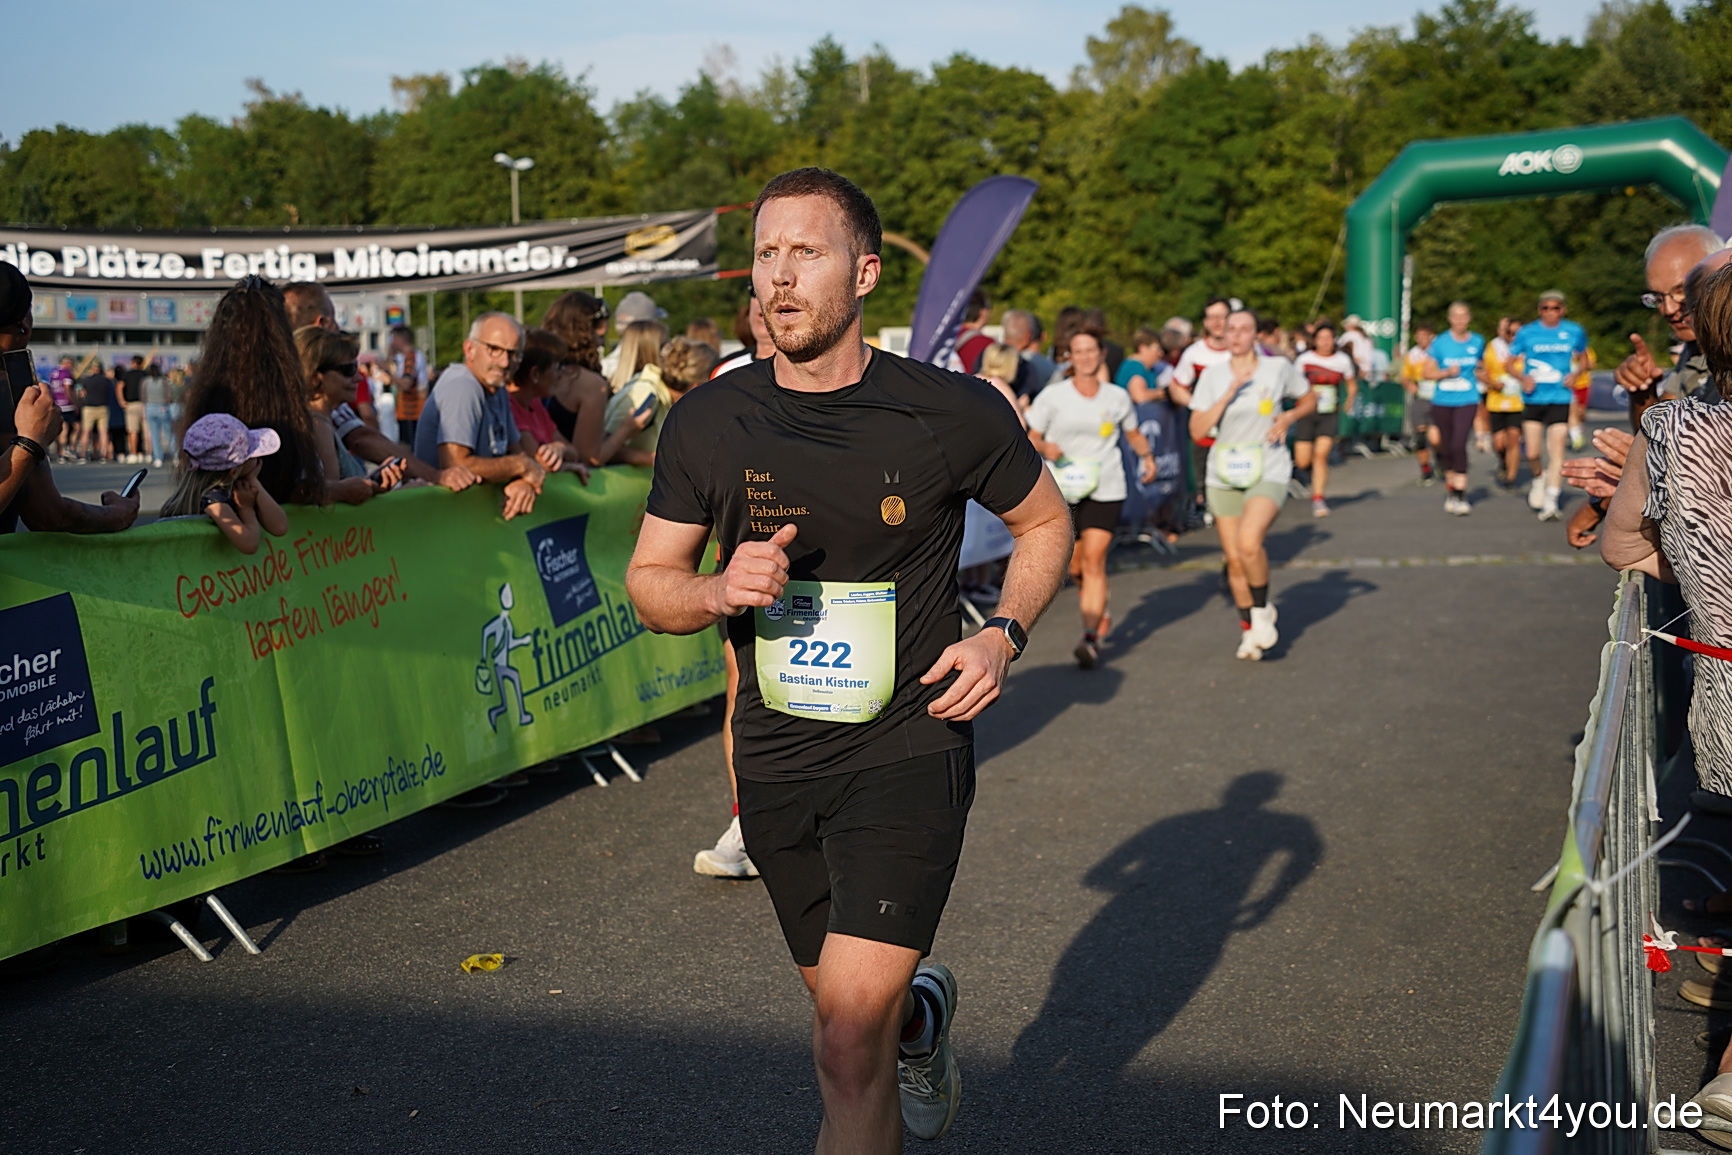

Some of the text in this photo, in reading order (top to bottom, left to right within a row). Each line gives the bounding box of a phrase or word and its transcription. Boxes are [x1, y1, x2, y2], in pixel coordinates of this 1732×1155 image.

[1498, 149, 1553, 176] AOK
[62, 245, 197, 279] Plätze.
[201, 244, 328, 283] Fertig.
[333, 241, 579, 279] Miteinander.
[744, 469, 775, 482] Fast.
[746, 487, 777, 501] Feet.
[749, 504, 810, 518] Fabulous.
[176, 526, 375, 619] Gesunde Firmen
[245, 556, 408, 661] laufen länger!
[787, 609, 828, 617] Firmenlauf
[789, 639, 852, 669] 222
[543, 666, 602, 712] neumarkt
[779, 672, 870, 689] Bastian Kistner
